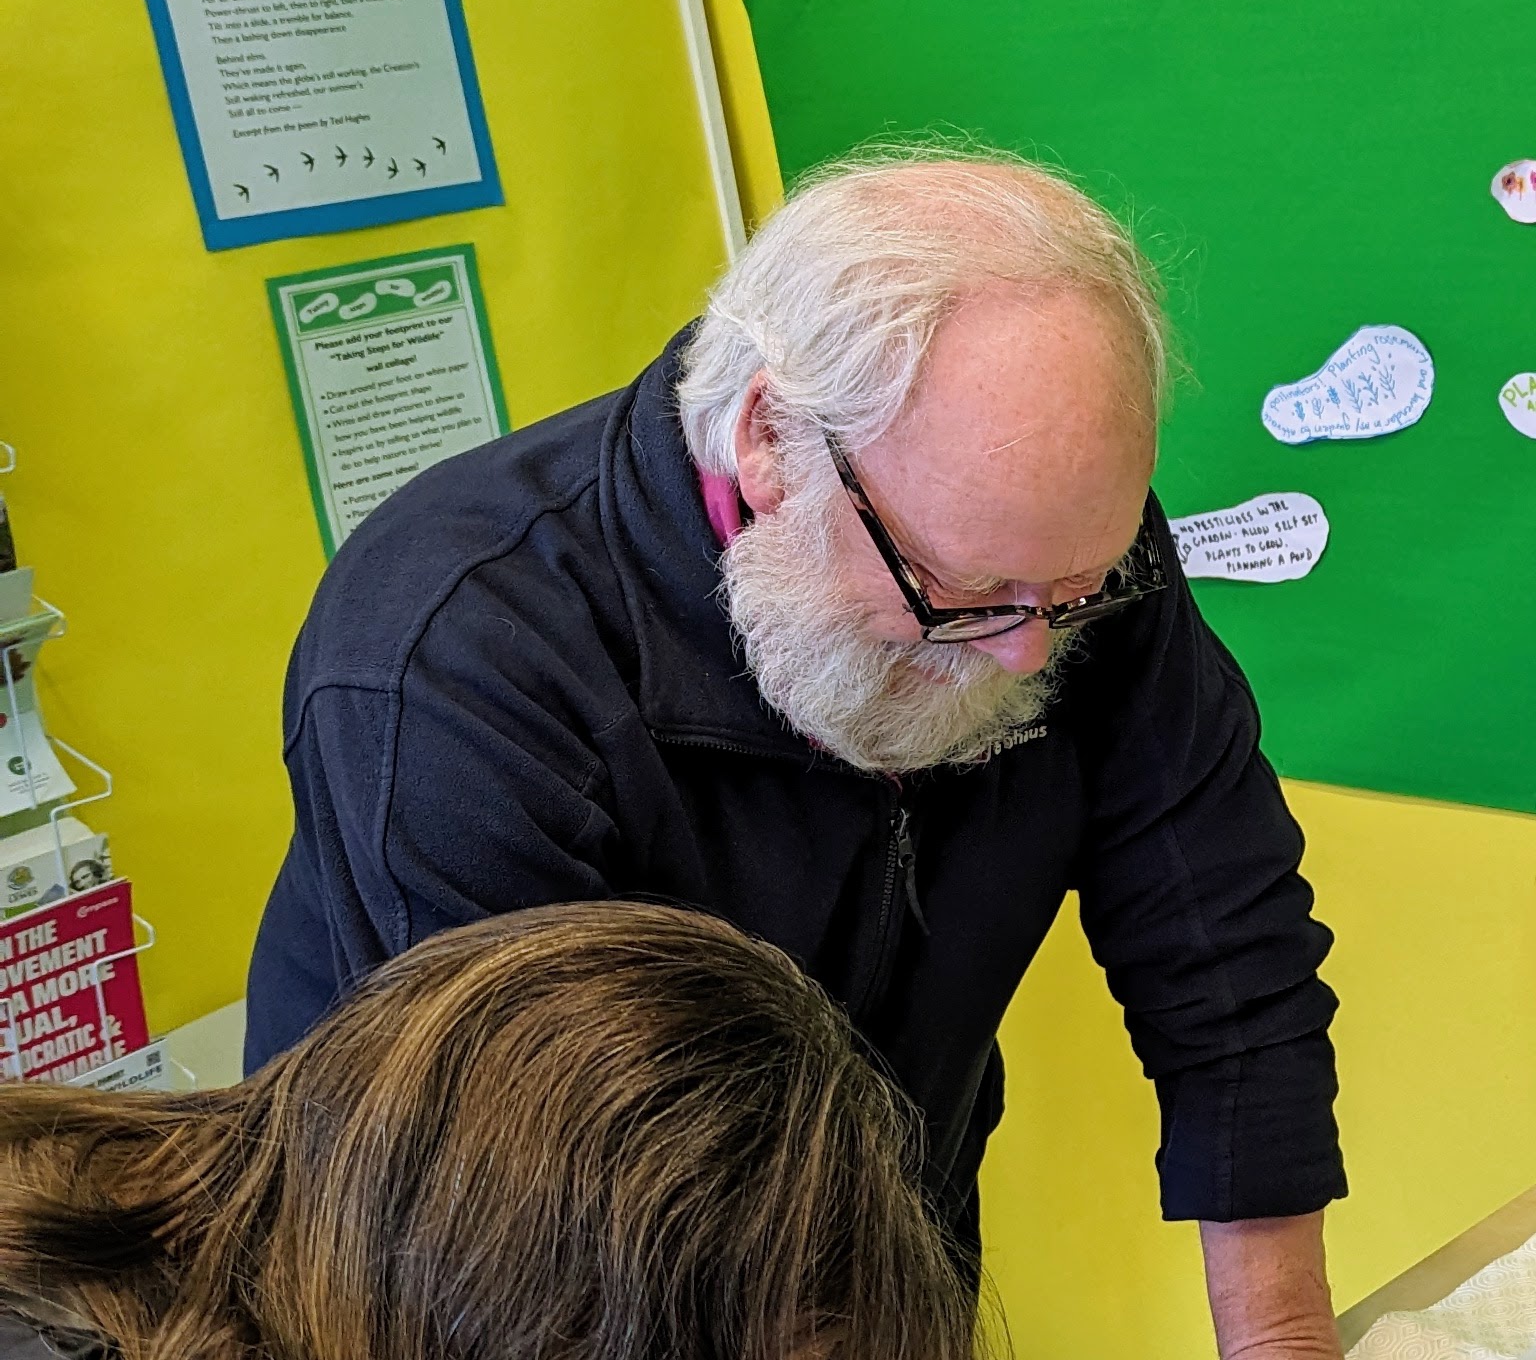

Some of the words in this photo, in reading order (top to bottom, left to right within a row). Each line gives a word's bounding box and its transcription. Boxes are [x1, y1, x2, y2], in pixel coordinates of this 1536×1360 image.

[1327, 342, 1380, 378] Planting
[1196, 511, 1254, 533] PESTICIDES
[1301, 512, 1319, 526] SET
[1205, 547, 1242, 562] PLANTS
[1246, 543, 1256, 555] TO
[1278, 554, 1285, 566] A
[1289, 549, 1313, 563] POND
[15, 919, 59, 955] THE
[12, 990, 31, 1017] A
[32, 962, 116, 1009] MORE
